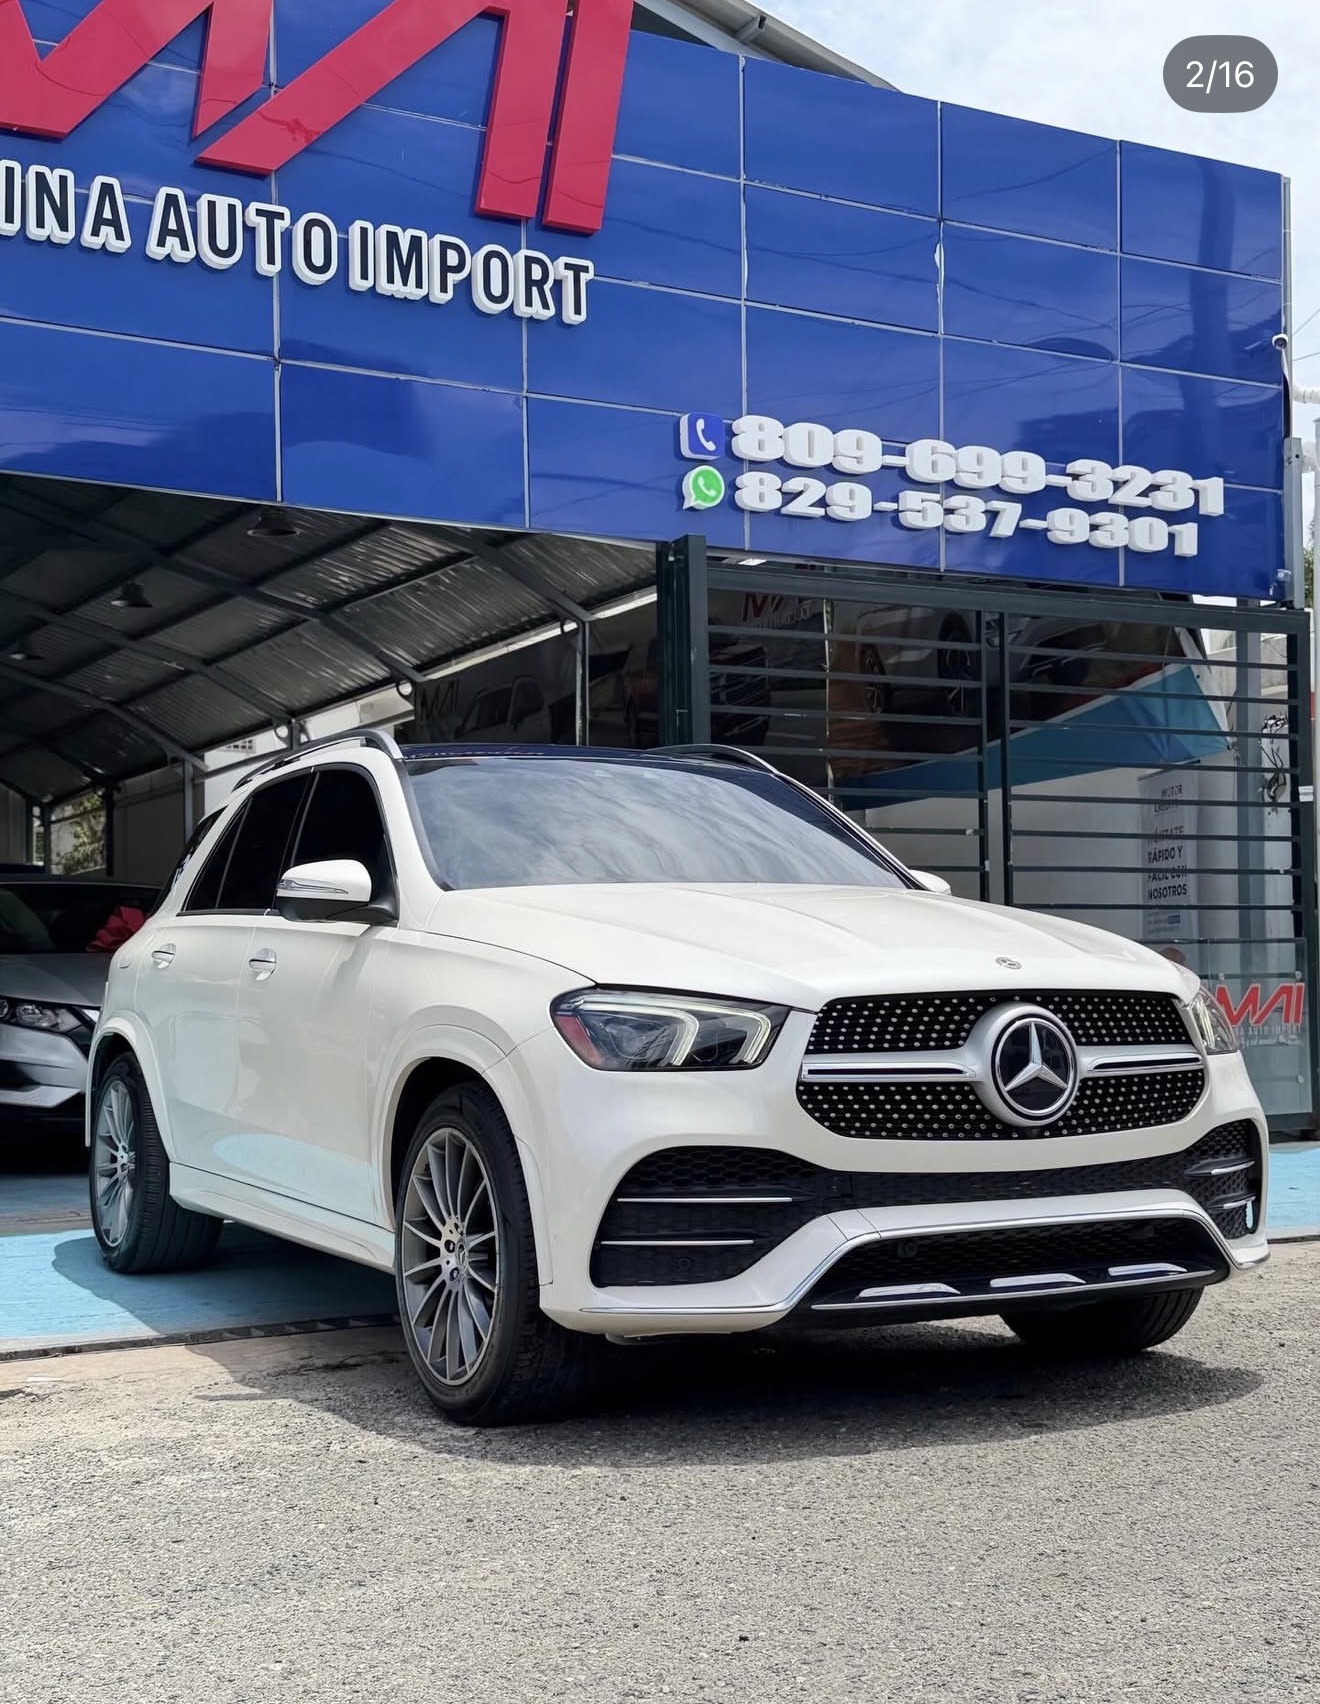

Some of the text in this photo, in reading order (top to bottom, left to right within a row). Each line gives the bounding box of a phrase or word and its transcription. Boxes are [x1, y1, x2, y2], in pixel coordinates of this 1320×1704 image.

[146, 187, 338, 285] AUTO
[349, 220, 594, 325] IMPORT
[731, 415, 1224, 516] 809-699-3231
[735, 471, 1198, 557] 829-537-9301
[1148, 883, 1187, 900] NOSOTROS
